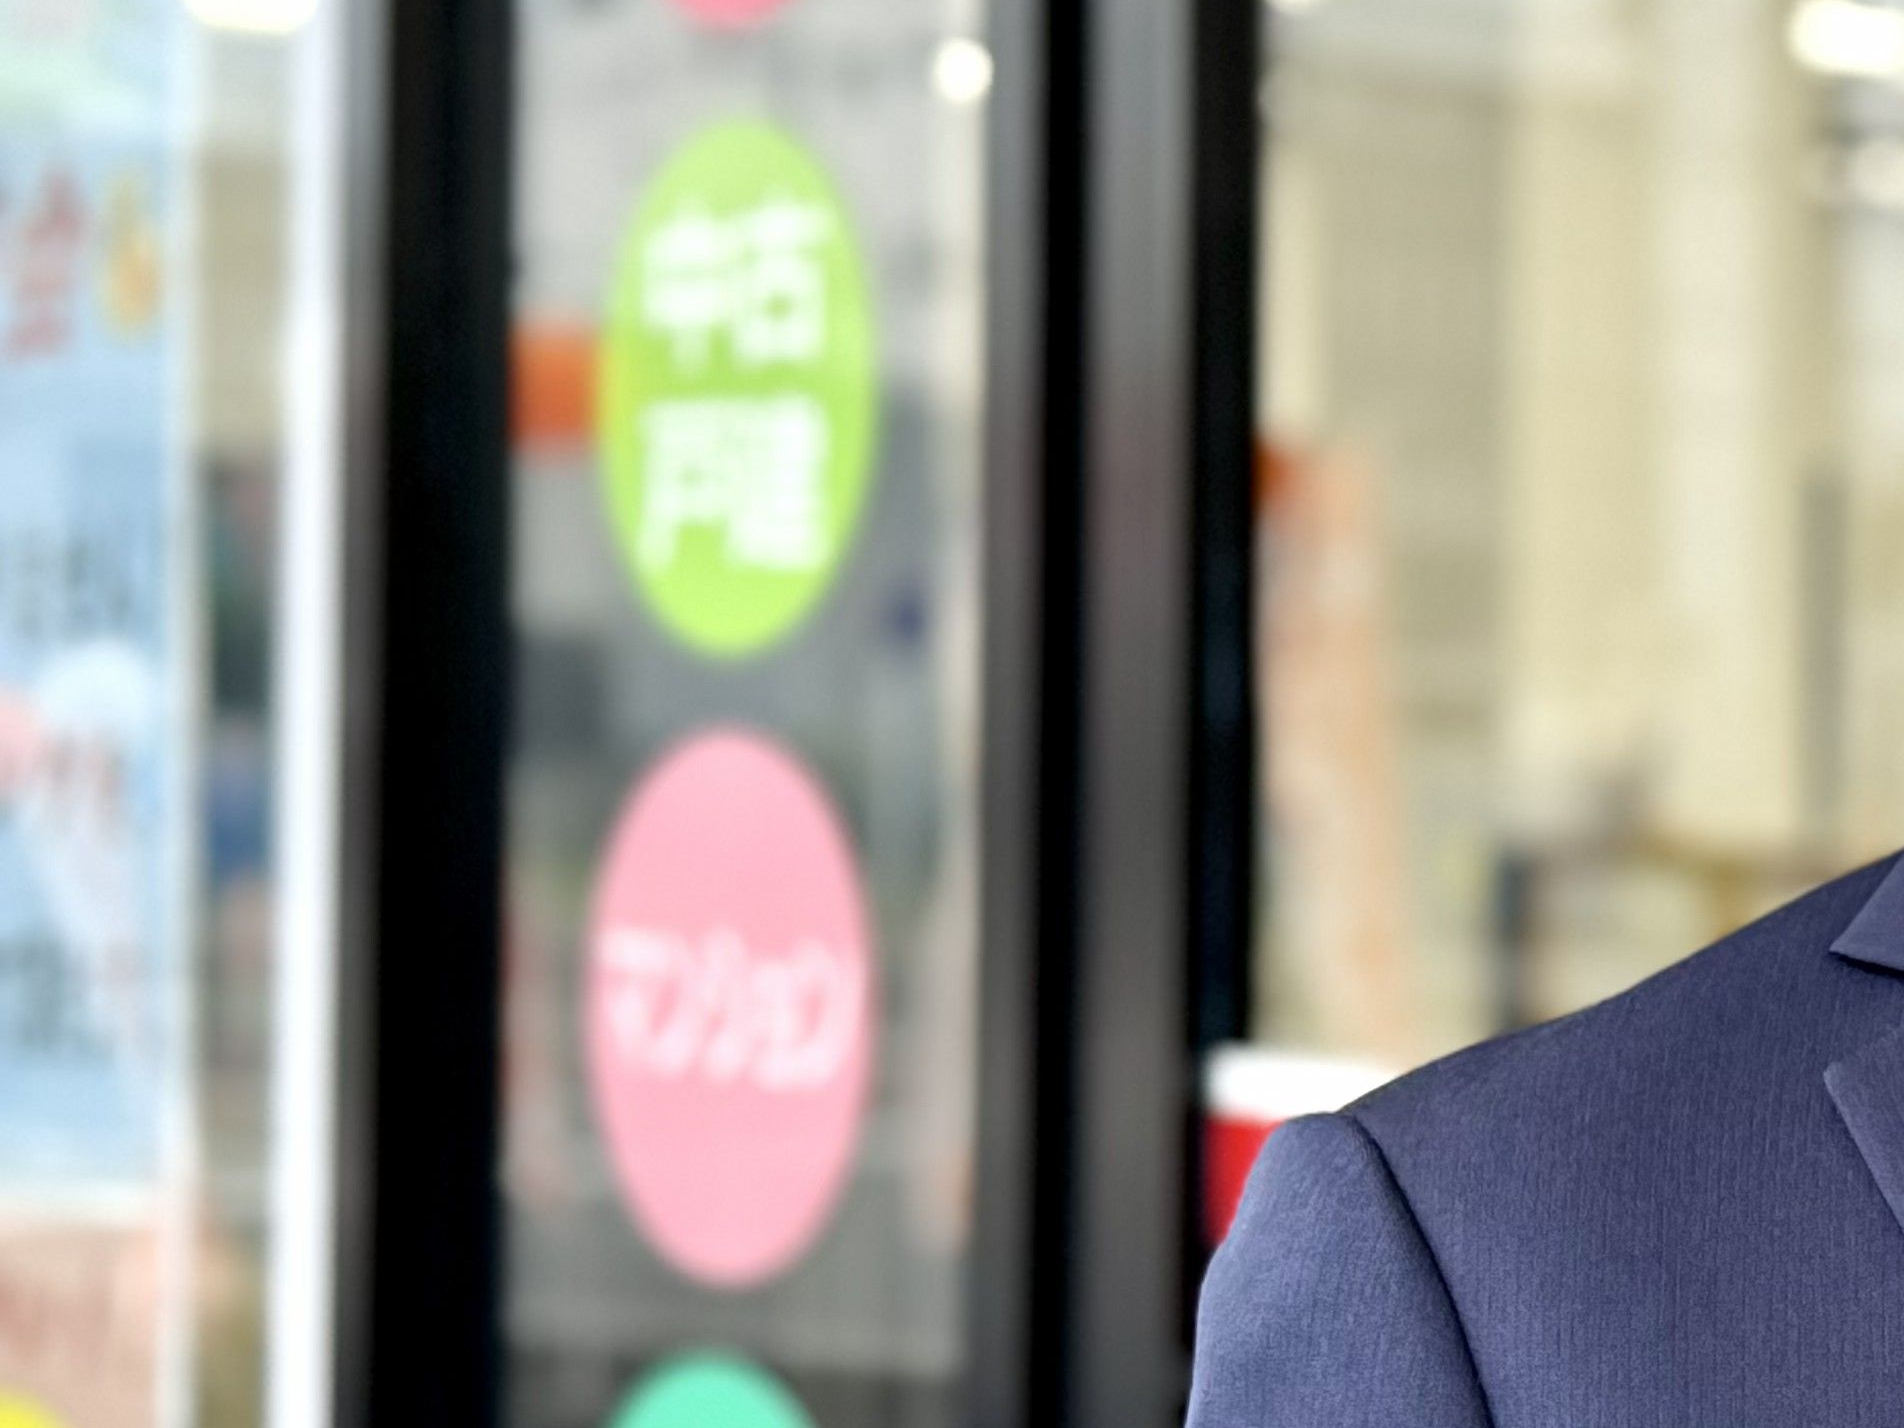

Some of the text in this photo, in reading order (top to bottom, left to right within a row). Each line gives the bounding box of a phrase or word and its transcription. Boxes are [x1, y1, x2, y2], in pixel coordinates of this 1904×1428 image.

[638, 194, 832, 374] 中古
[602, 926, 866, 1092] マンション
